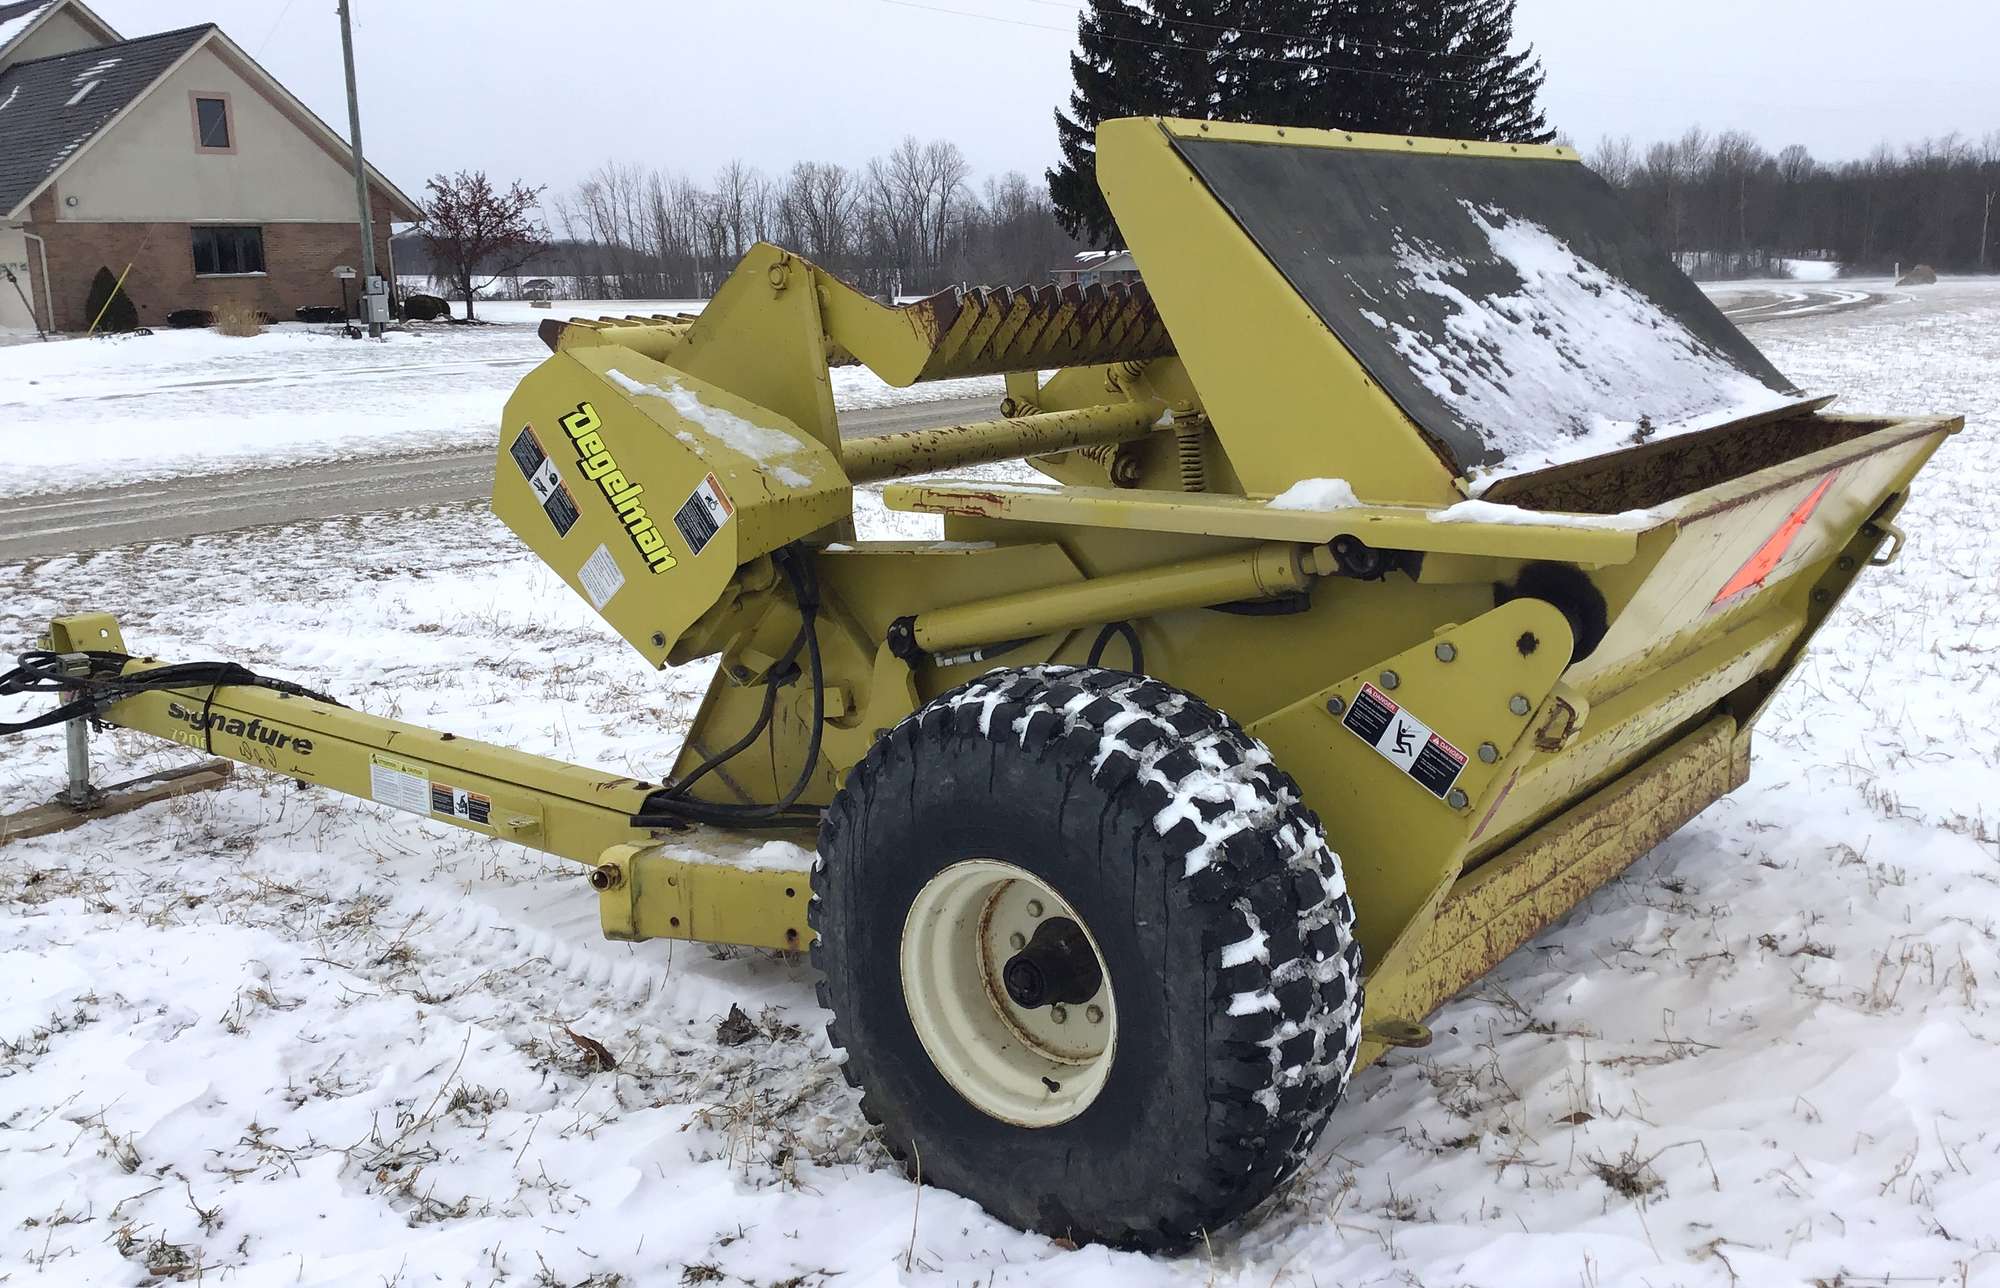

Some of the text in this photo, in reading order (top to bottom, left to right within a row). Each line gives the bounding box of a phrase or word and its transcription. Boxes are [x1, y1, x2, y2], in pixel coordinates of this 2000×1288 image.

[558, 401, 678, 575] Degelman
[1372, 691, 1396, 711] DANGER
[1439, 742, 1464, 762] DANGER
